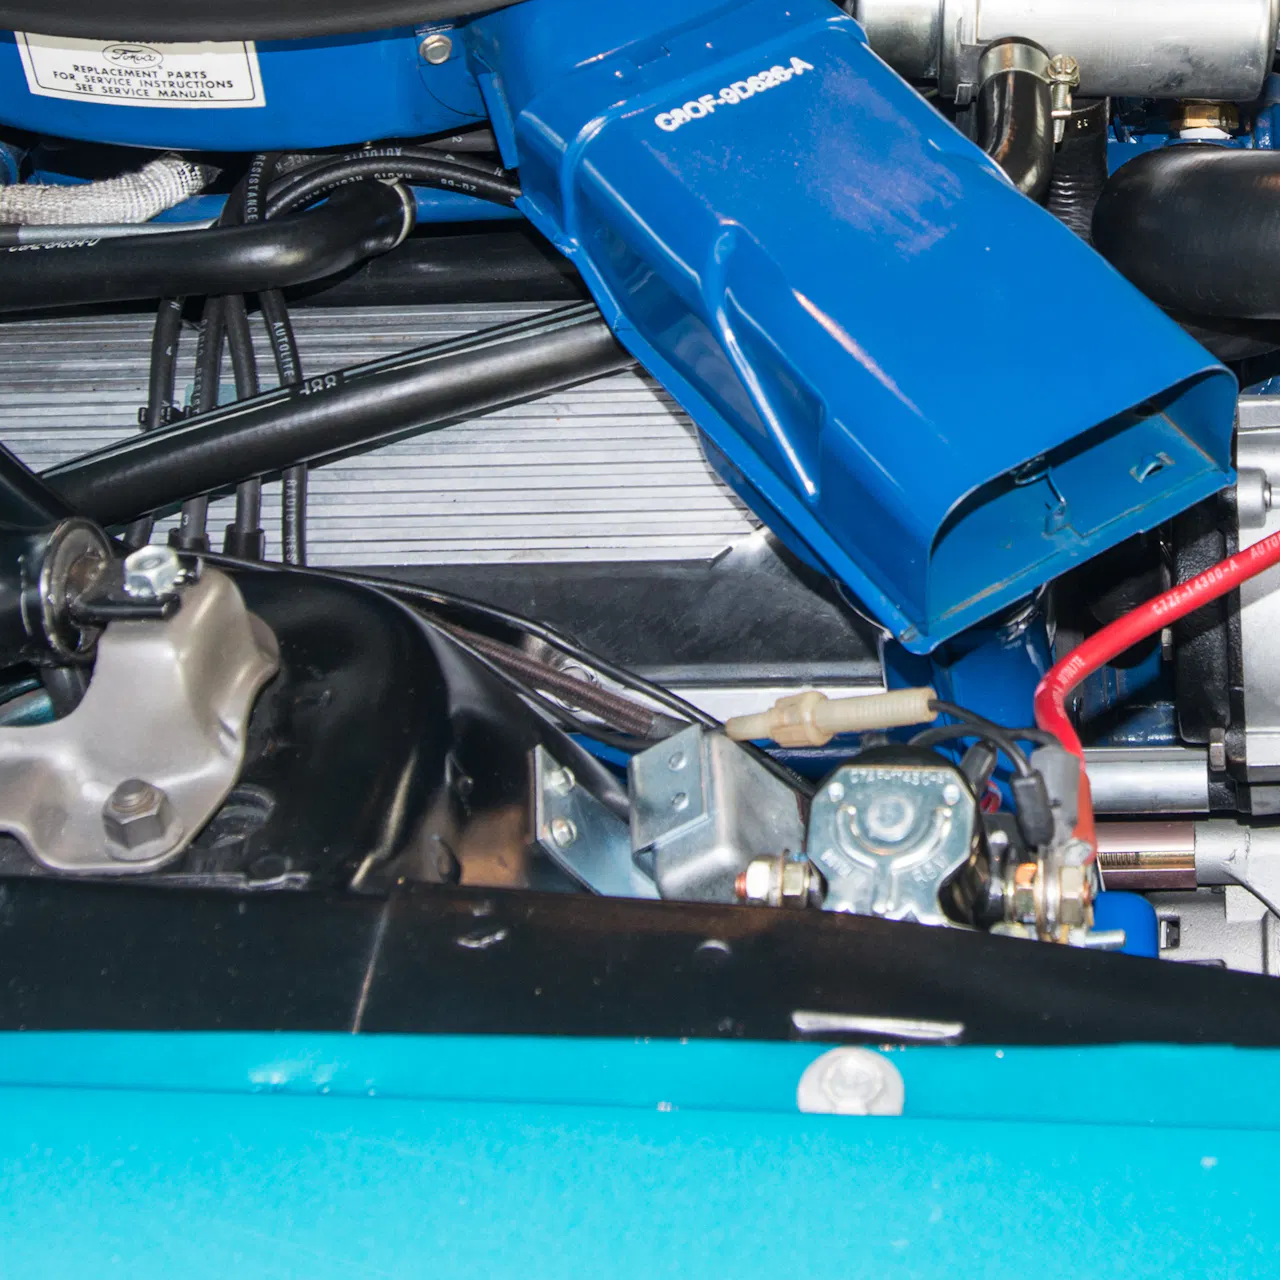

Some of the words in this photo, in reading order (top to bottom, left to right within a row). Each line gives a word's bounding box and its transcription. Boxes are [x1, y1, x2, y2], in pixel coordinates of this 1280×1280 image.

[53, 70, 77, 81] FOR
[83, 74, 132, 87] SERVICE
[139, 78, 234, 89] INSTRUCTIONS
[72, 64, 158, 79] REPLACEMENT
[167, 70, 208, 79] PARTS
[74, 82, 94, 92] SEE
[102, 85, 150, 97] SERVICE
[158, 89, 214, 99] MANUAL
[244, 154, 266, 222] RESISTANCE
[273, 321, 295, 379] AUTOLITE
